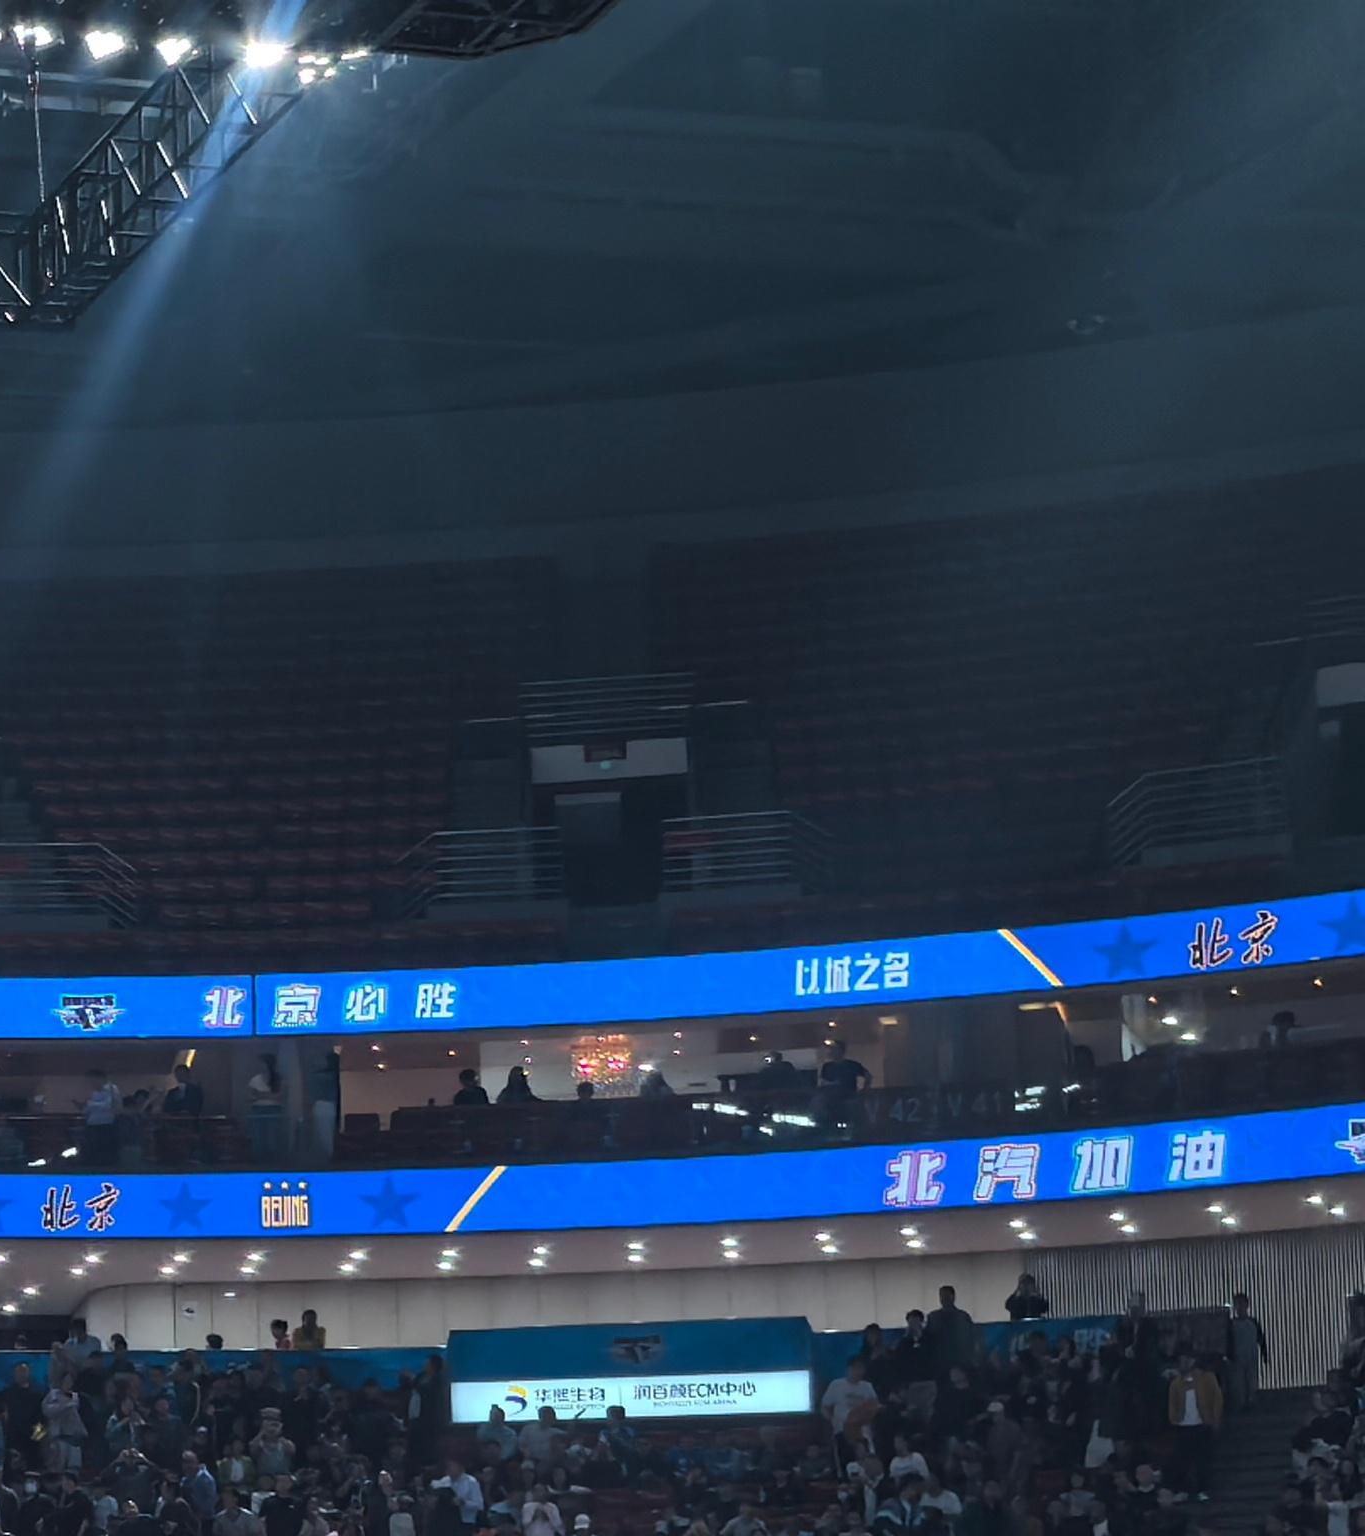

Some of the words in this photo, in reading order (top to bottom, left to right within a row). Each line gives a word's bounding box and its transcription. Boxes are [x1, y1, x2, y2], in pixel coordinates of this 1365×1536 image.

[1188, 911, 1280, 970] 北京
[795, 951, 911, 998] 以城之名
[203, 981, 458, 1028] 北京必胜
[884, 1130, 1228, 1208] 北汽加油
[42, 1183, 122, 1233] 北京
[260, 1190, 310, 1227] BEIJING
